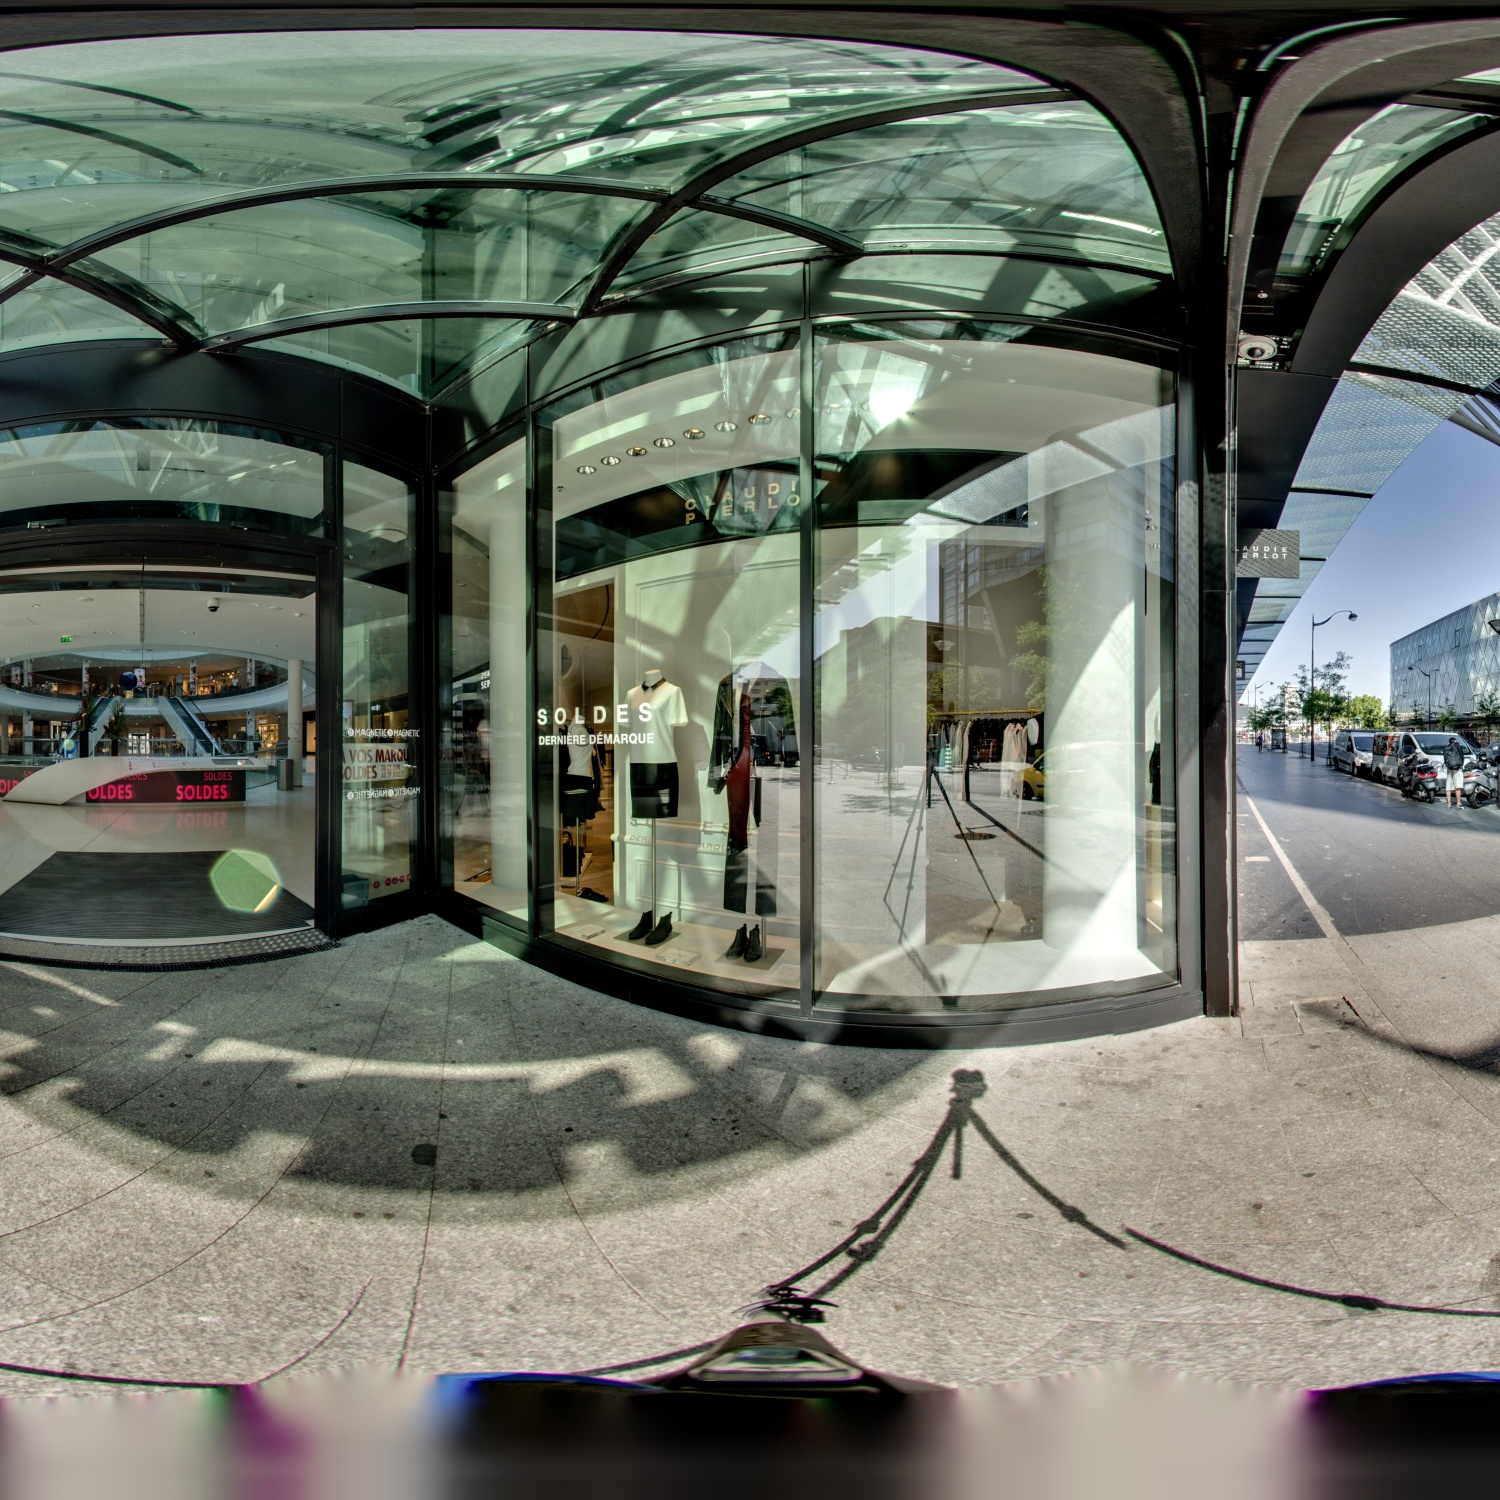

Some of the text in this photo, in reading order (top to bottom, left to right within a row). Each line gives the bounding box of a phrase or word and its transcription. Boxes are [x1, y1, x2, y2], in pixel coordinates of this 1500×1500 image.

[684, 480, 800, 511] CLAUDI
[685, 494, 801, 525] PIERLO
[1236, 545, 1288, 553] AUDIE
[1242, 552, 1288, 560] ERLOT
[537, 703, 653, 726] SOLDES
[393, 729, 420, 737] MAGNETIC
[538, 732, 655, 746] DERNIÈRE DÉMARQUE
[349, 750, 373, 764] VOS
[375, 748, 408, 763] MARQU
[203, 771, 233, 781] SOLDES
[344, 765, 378, 780] OLDES
[88, 784, 133, 800] OLDES
[176, 784, 229, 800] SOLDES
